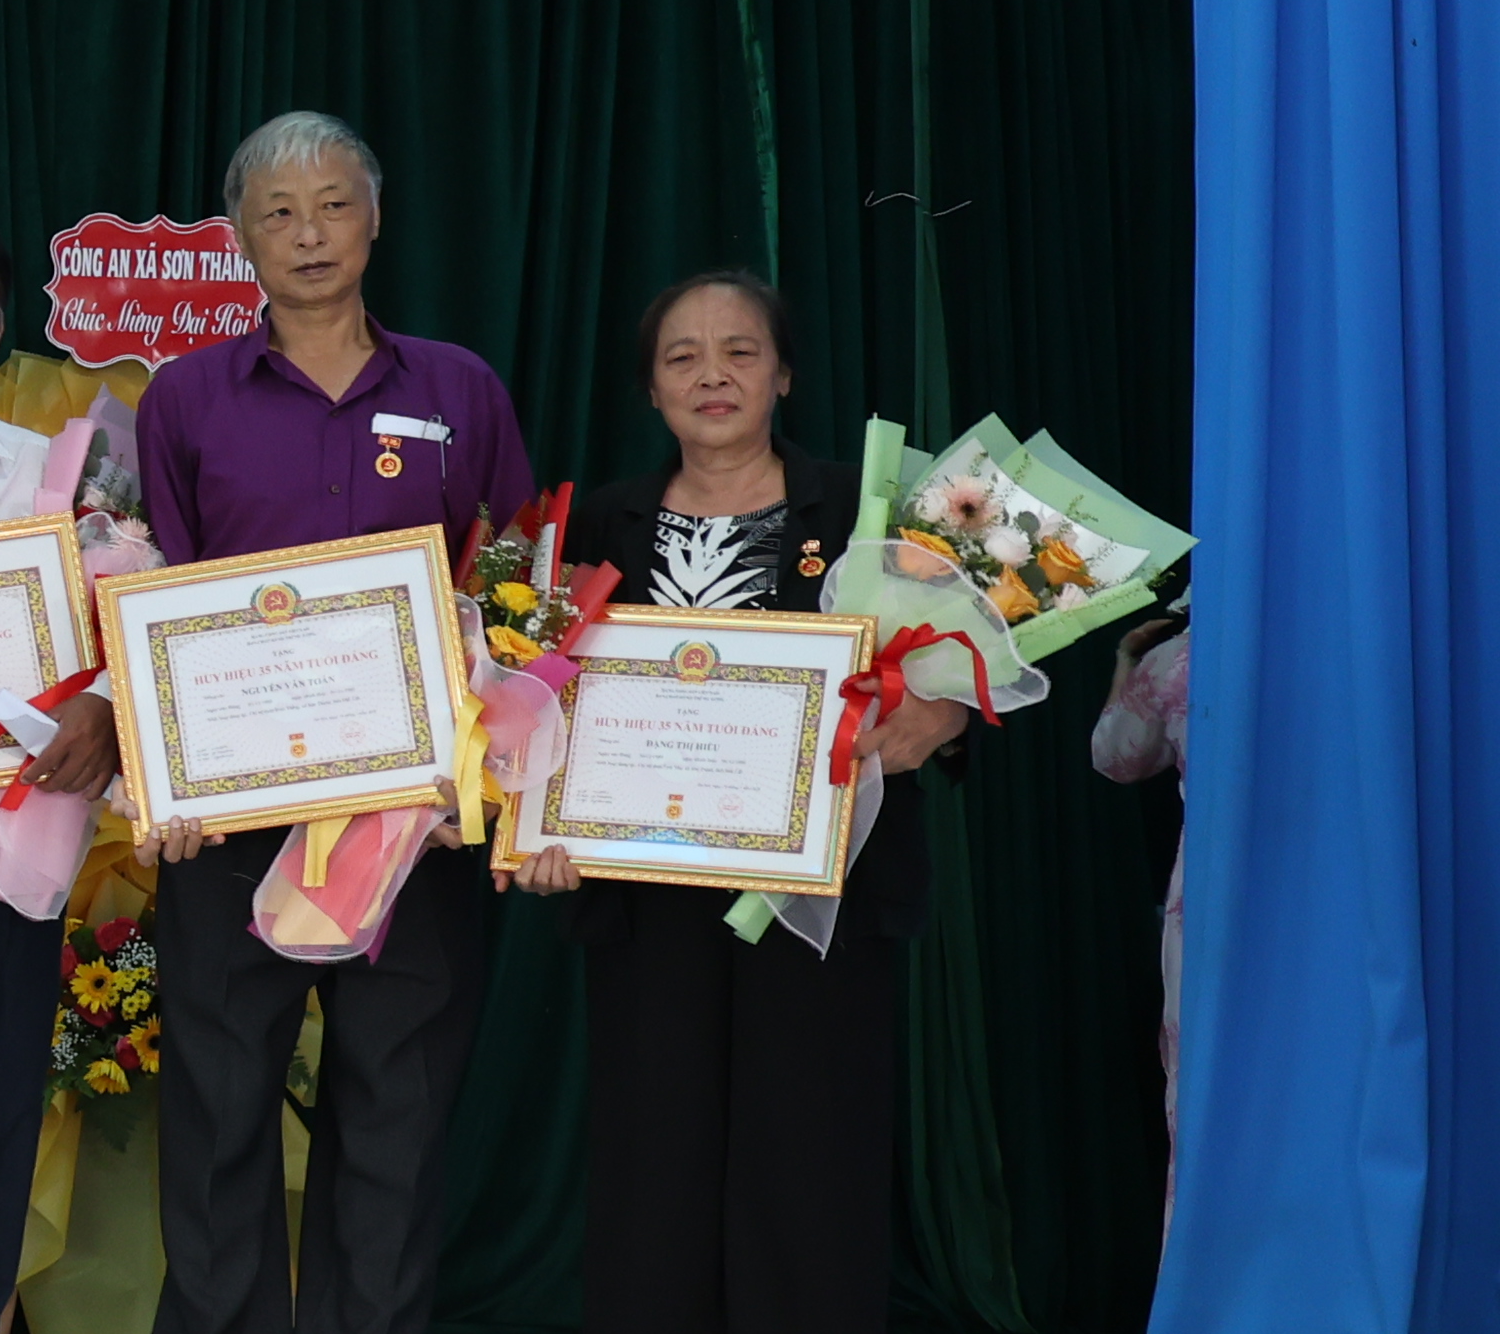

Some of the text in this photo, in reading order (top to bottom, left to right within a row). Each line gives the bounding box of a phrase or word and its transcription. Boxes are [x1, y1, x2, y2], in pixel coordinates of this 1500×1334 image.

[60, 239, 103, 278] CÔNG
[106, 249, 131, 280] AN
[134, 242, 157, 280] XÃ
[161, 248, 195, 281] SƠN
[61, 297, 105, 332] Chúc
[108, 299, 163, 346] Mừng
[171, 300, 208, 345] Đại
